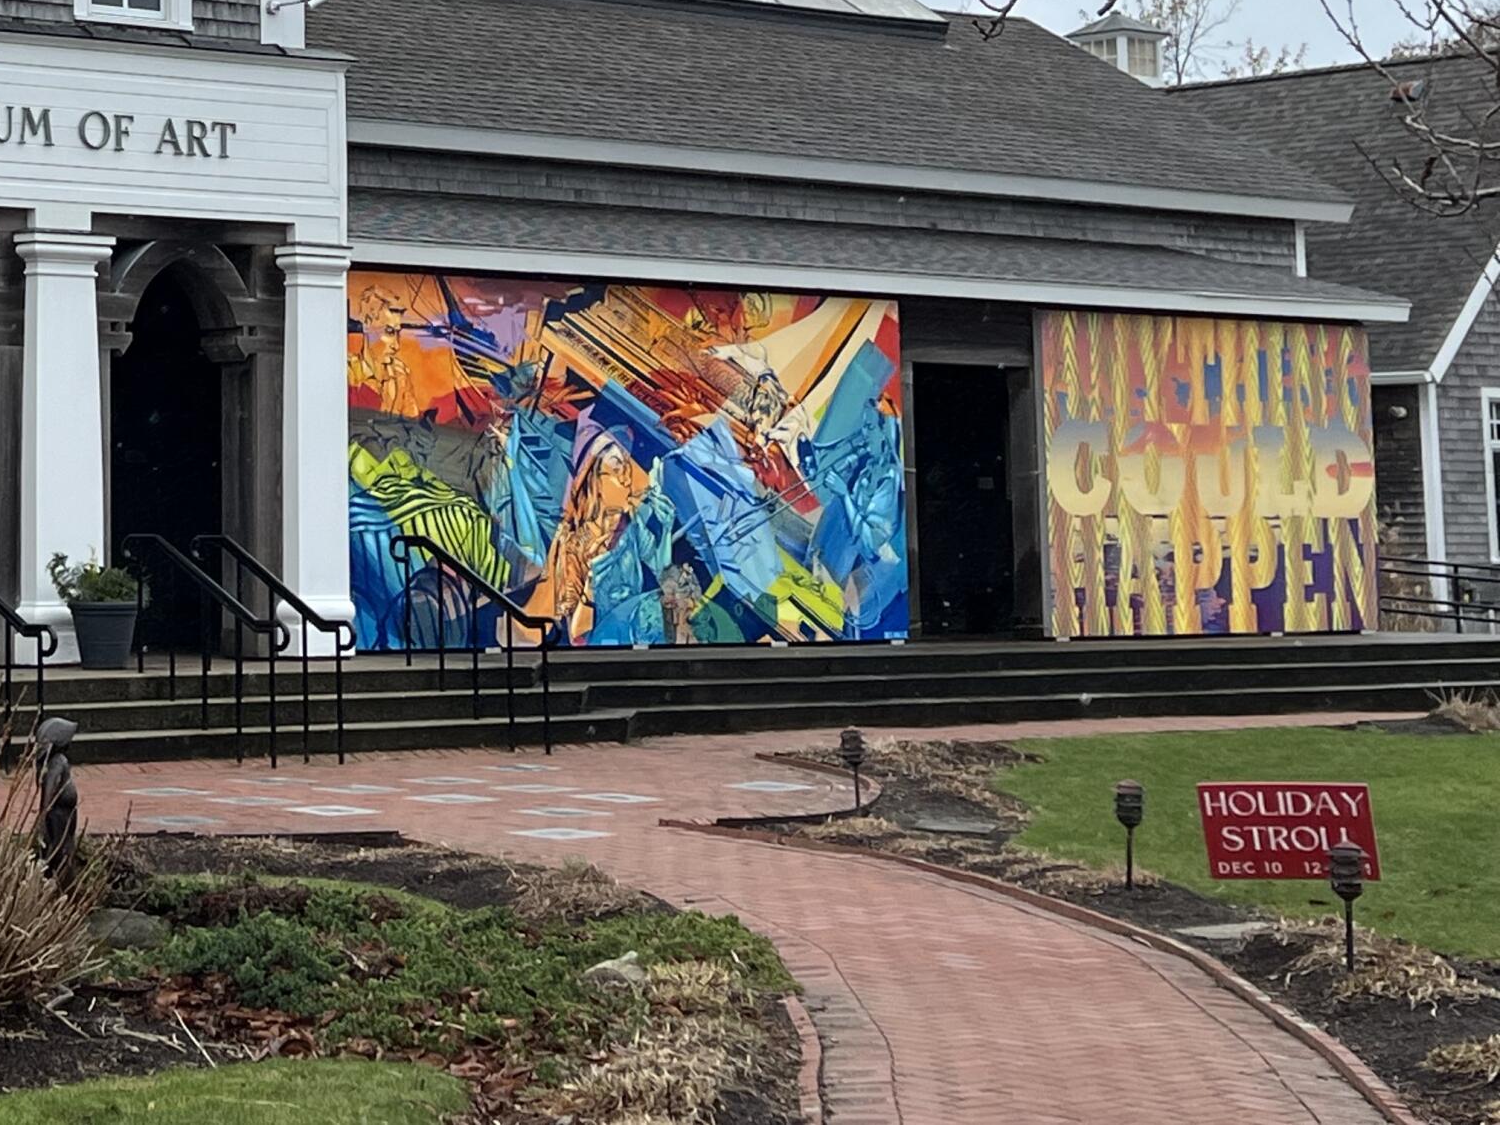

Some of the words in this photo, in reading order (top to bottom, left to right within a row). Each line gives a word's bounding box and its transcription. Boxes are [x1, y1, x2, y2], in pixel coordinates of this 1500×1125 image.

[78, 110, 135, 152] OF
[155, 117, 237, 160] ART
[1046, 420, 1374, 518] COULD
[1049, 515, 1379, 637] HAPPEN
[1203, 790, 1364, 818] HOLIDAY
[1218, 860, 1256, 875] DEC
[1264, 860, 1283, 874] 10
